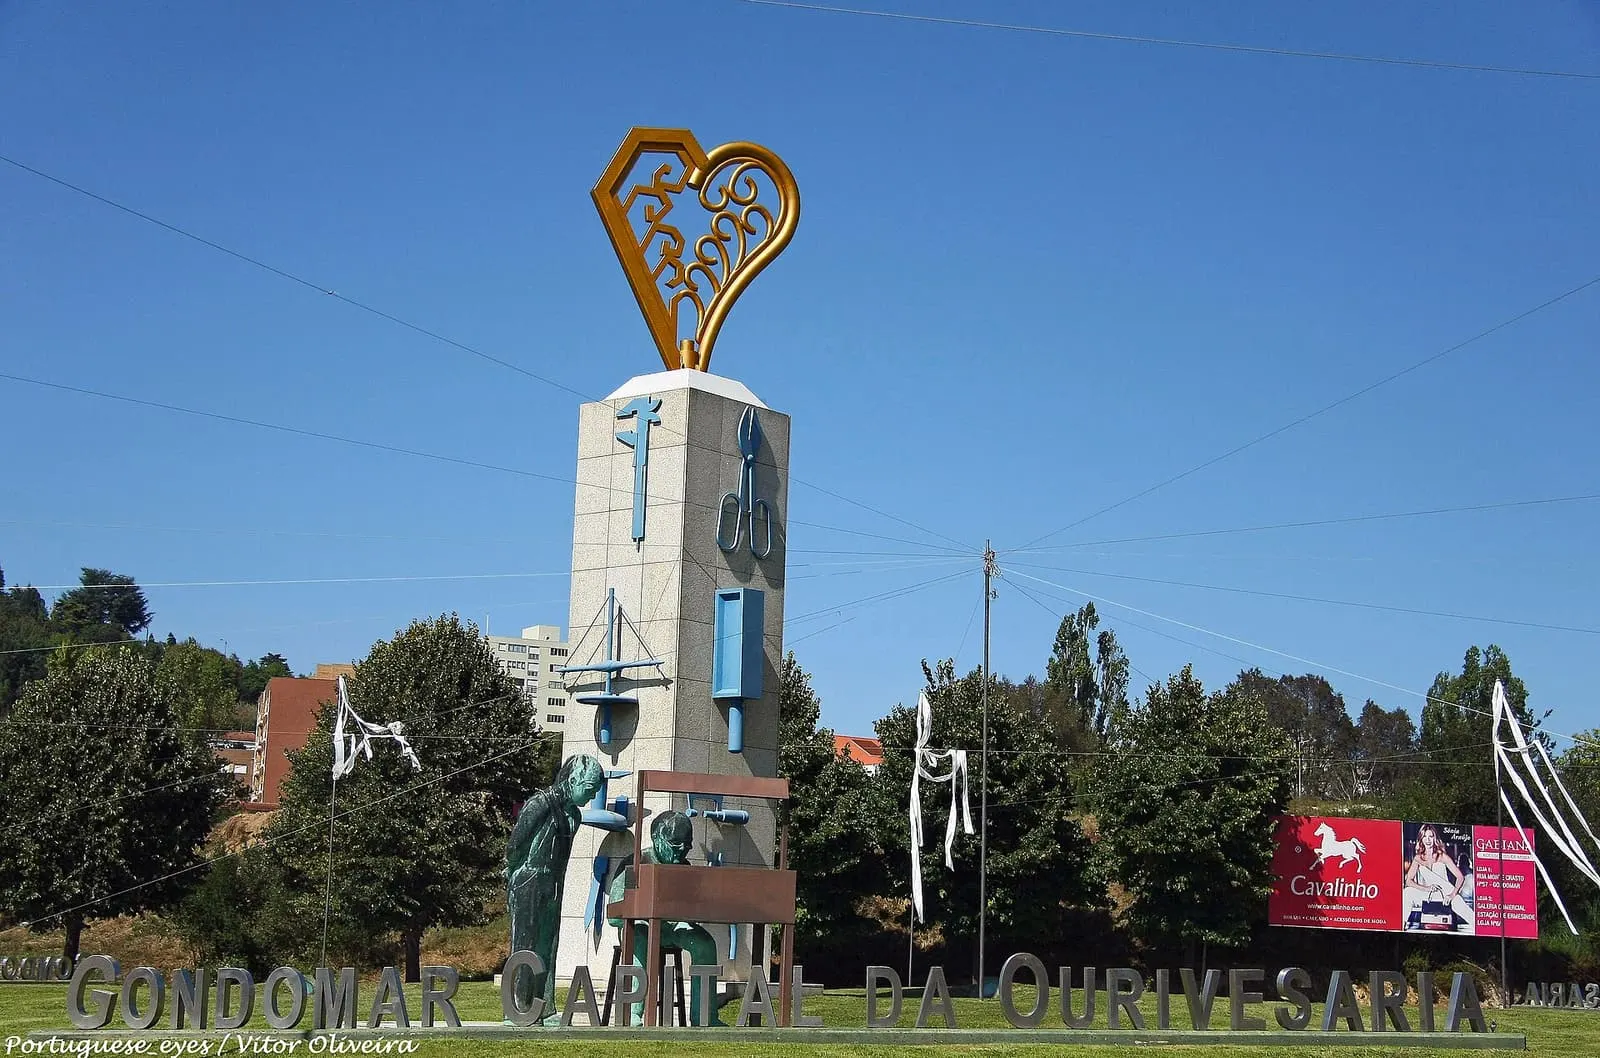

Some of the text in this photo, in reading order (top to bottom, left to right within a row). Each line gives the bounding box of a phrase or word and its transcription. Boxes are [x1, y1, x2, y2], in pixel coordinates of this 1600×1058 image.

[1290, 875, 1379, 899] Cavalinho
[1492, 881, 1521, 889] GODOMAR
[67, 950, 1488, 1032] GONDOMAR CAPITAL DA OURIVESARIA
